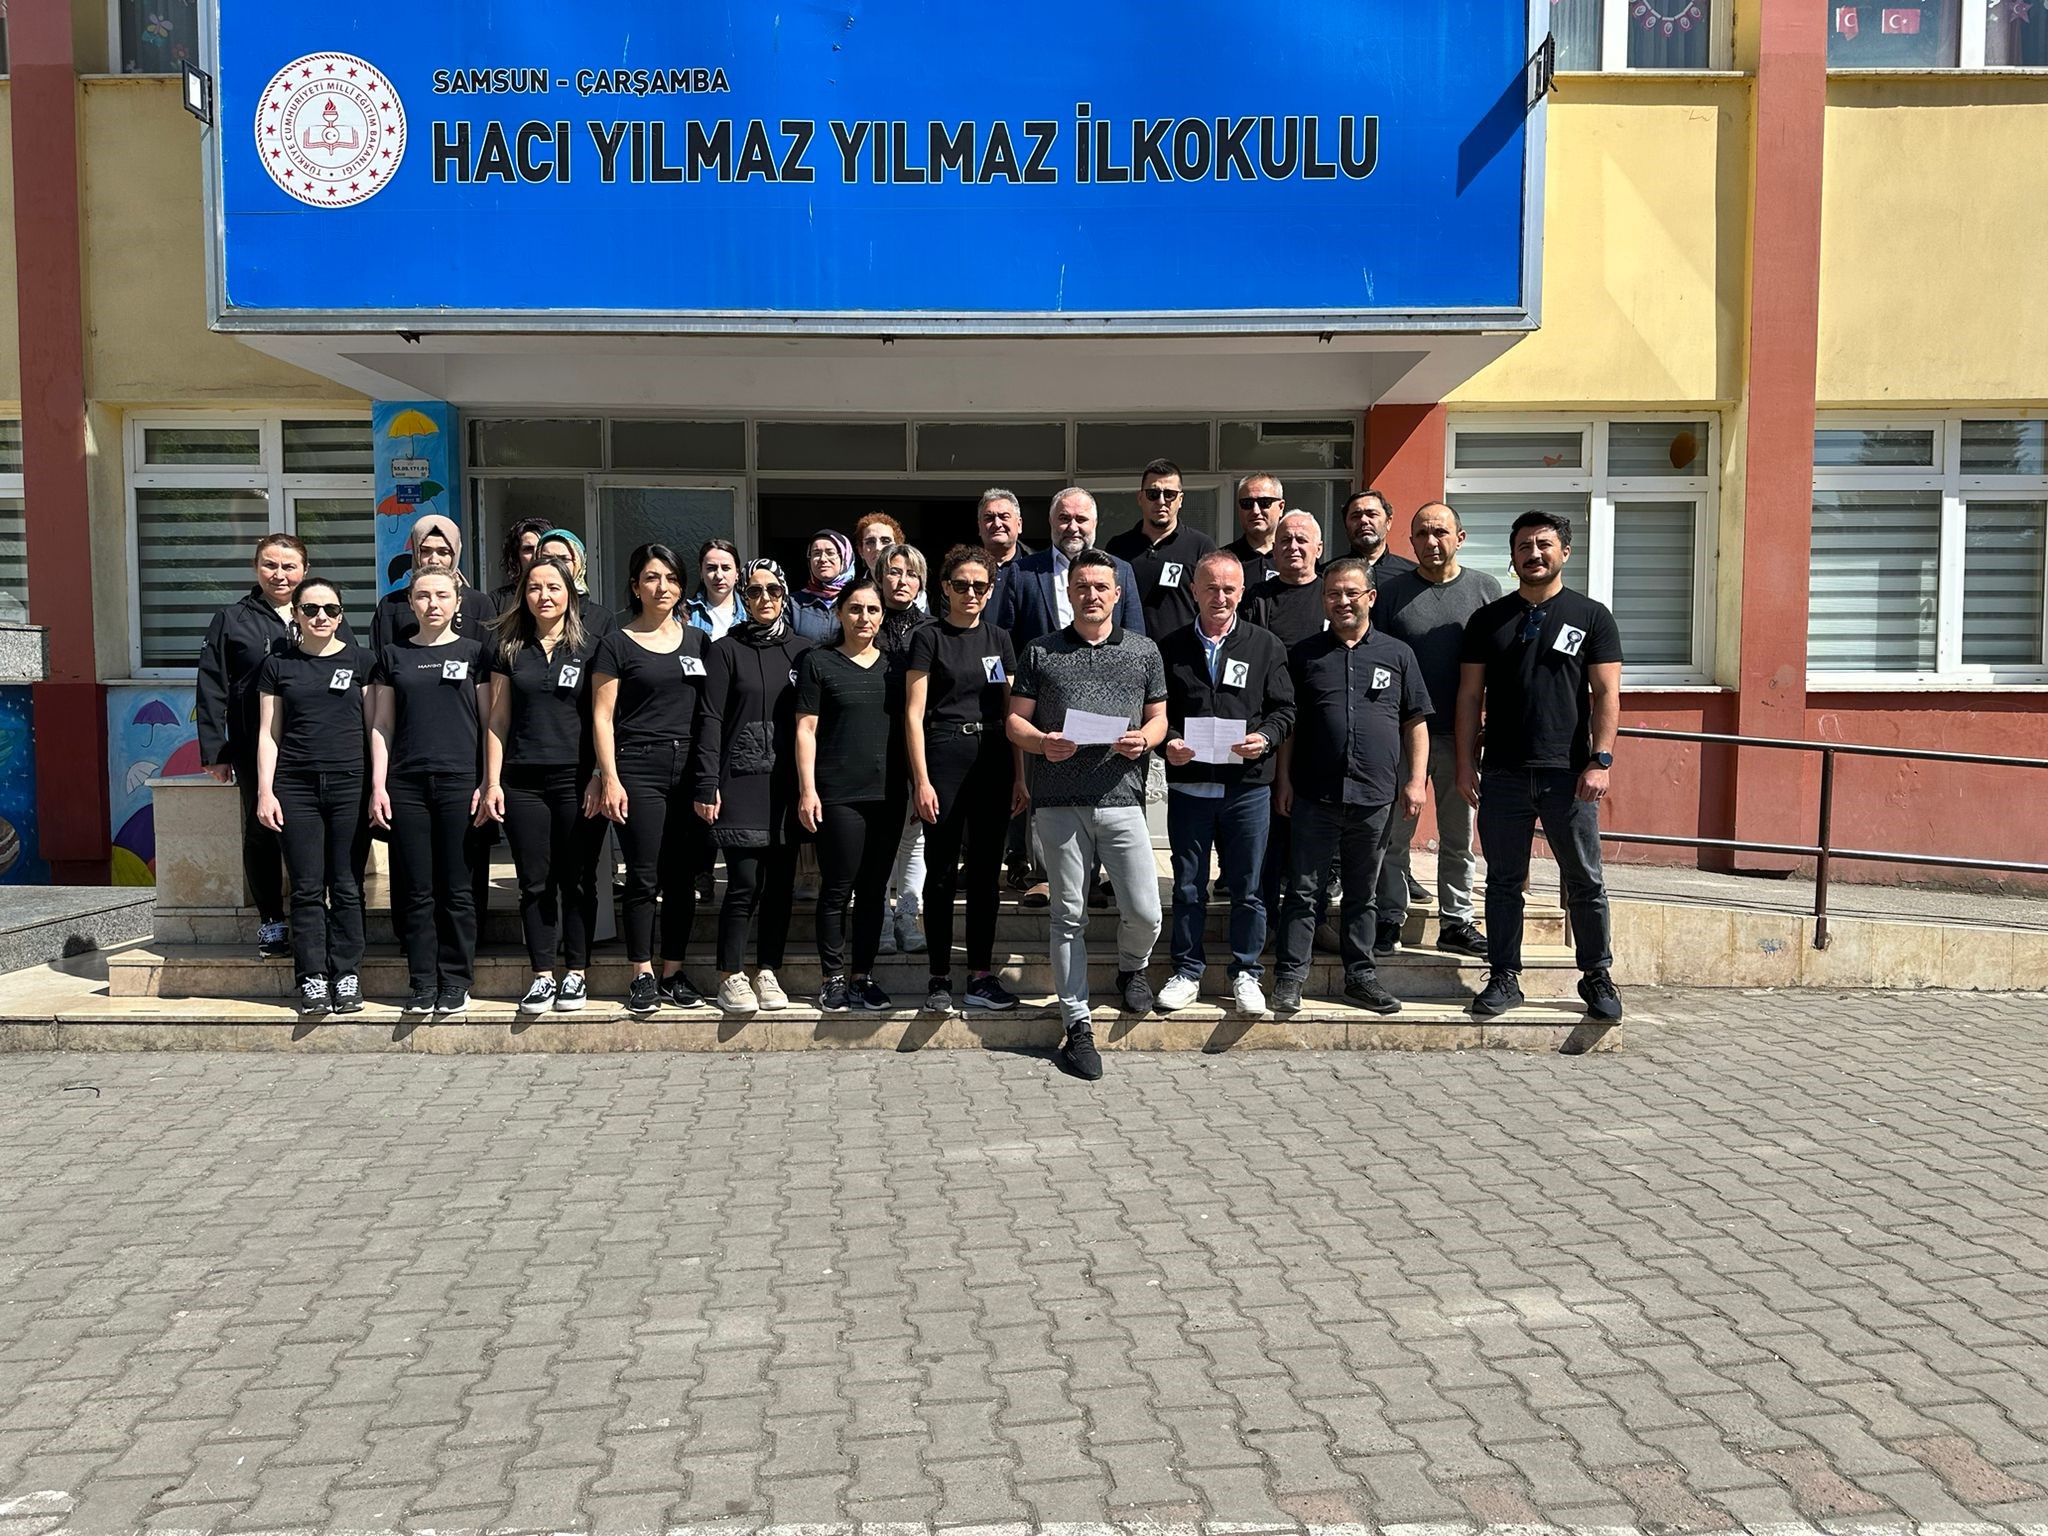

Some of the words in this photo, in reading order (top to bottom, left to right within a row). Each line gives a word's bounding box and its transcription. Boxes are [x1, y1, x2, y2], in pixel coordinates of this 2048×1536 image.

[326, 82, 354, 95] MİLLİ
[432, 68, 549, 94] SAMSUN
[575, 67, 730, 97] ÇARŞAMBA
[284, 82, 324, 141] CUMHURİYETİ
[355, 93, 377, 127] EĞİTİM
[287, 144, 322, 176] TÜRKİYE
[342, 130, 378, 176] BAKANLIĞI
[432, 120, 571, 183] HACI
[586, 119, 815, 183] YILMAZ
[828, 120, 1059, 184] YILMAZ
[1076, 102, 1379, 183] İLKOKULU
